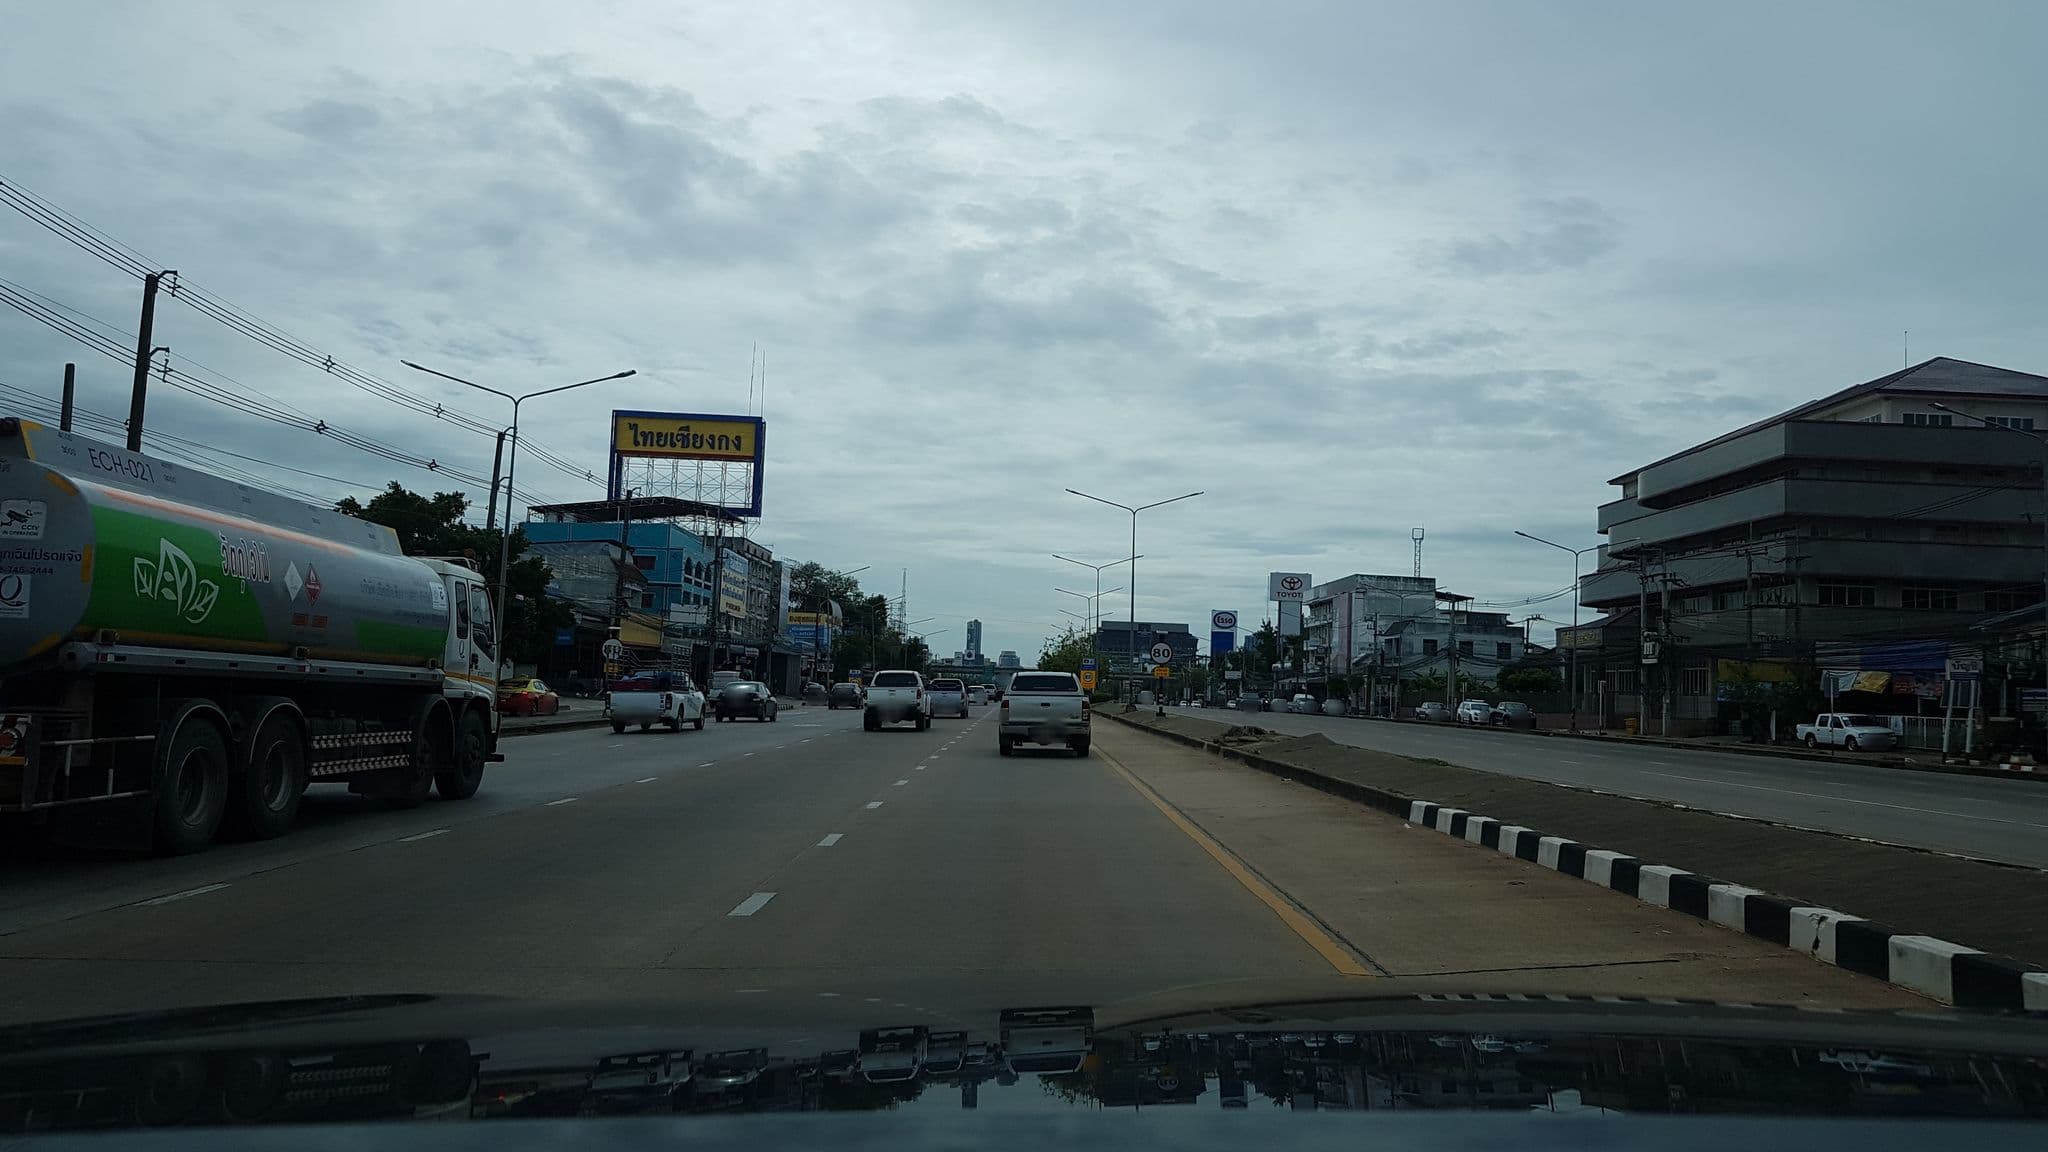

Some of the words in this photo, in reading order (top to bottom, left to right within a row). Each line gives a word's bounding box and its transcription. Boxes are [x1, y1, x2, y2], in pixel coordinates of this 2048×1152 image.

[88, 447, 155, 483] ECH-021
[1217, 615, 1233, 624] Esso
[1152, 648, 1171, 658] 80
